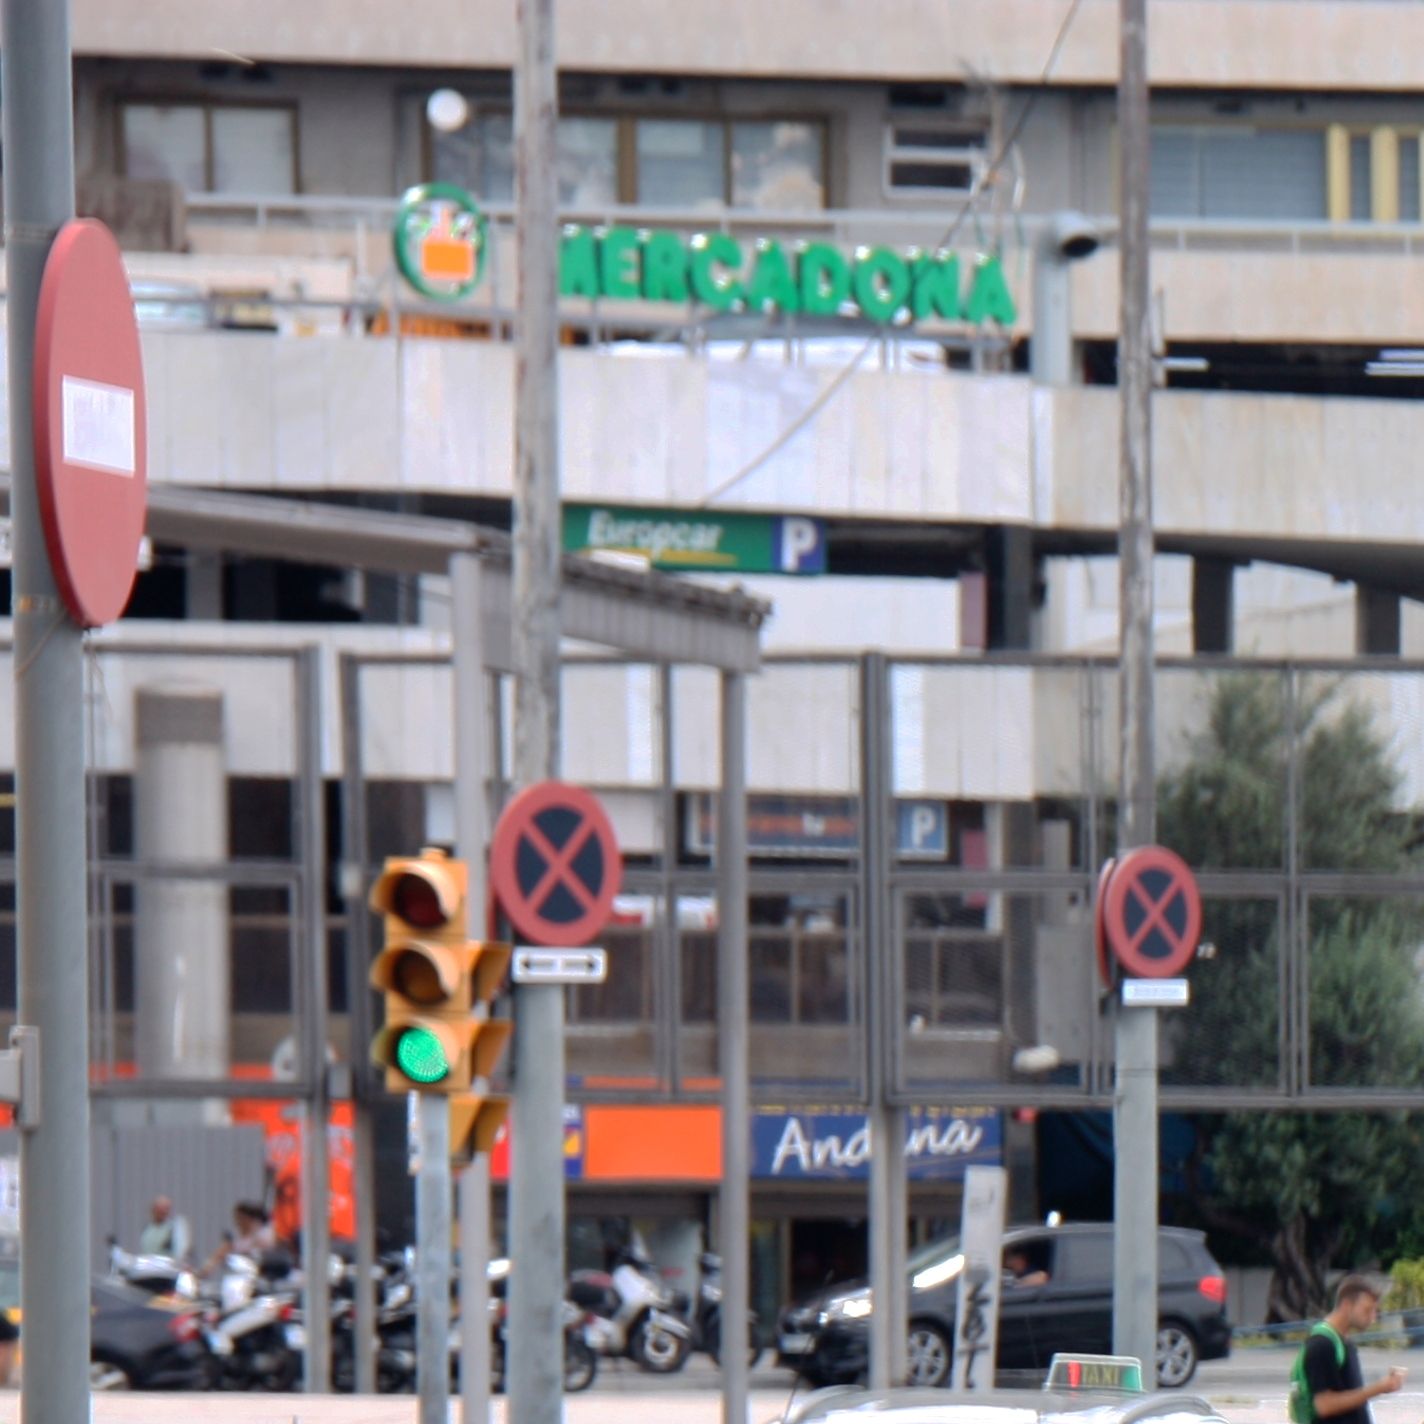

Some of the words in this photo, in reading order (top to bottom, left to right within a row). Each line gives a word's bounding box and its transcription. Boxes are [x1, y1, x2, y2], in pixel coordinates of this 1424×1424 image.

[559, 224, 1017, 325] MERCADONA
[587, 510, 724, 560] Europcar
[780, 517, 818, 572] P
[1081, 1362, 1119, 1387] TAXI
